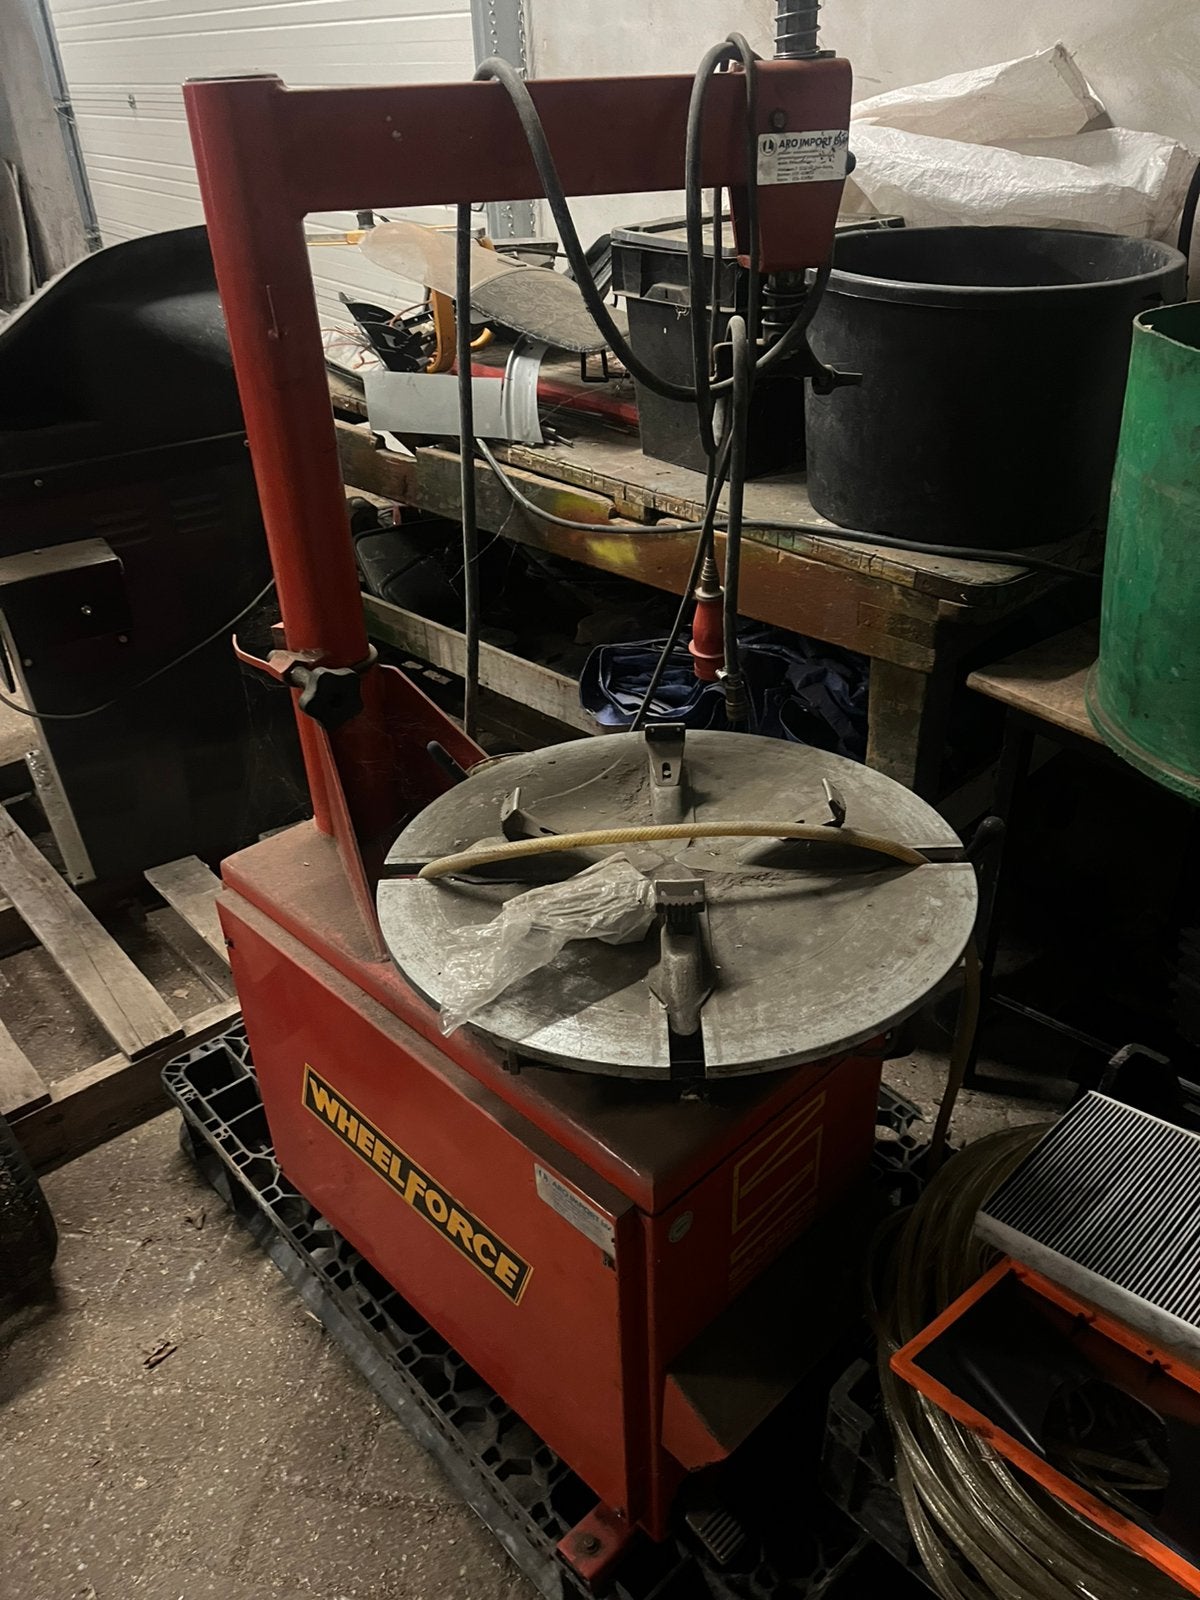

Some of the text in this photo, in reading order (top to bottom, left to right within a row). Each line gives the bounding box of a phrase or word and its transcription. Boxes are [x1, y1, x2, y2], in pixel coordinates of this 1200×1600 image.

[779, 139, 798, 149] ARO
[800, 137, 832, 147] IMPORT
[309, 1076, 519, 1289] WHEELFORCE
